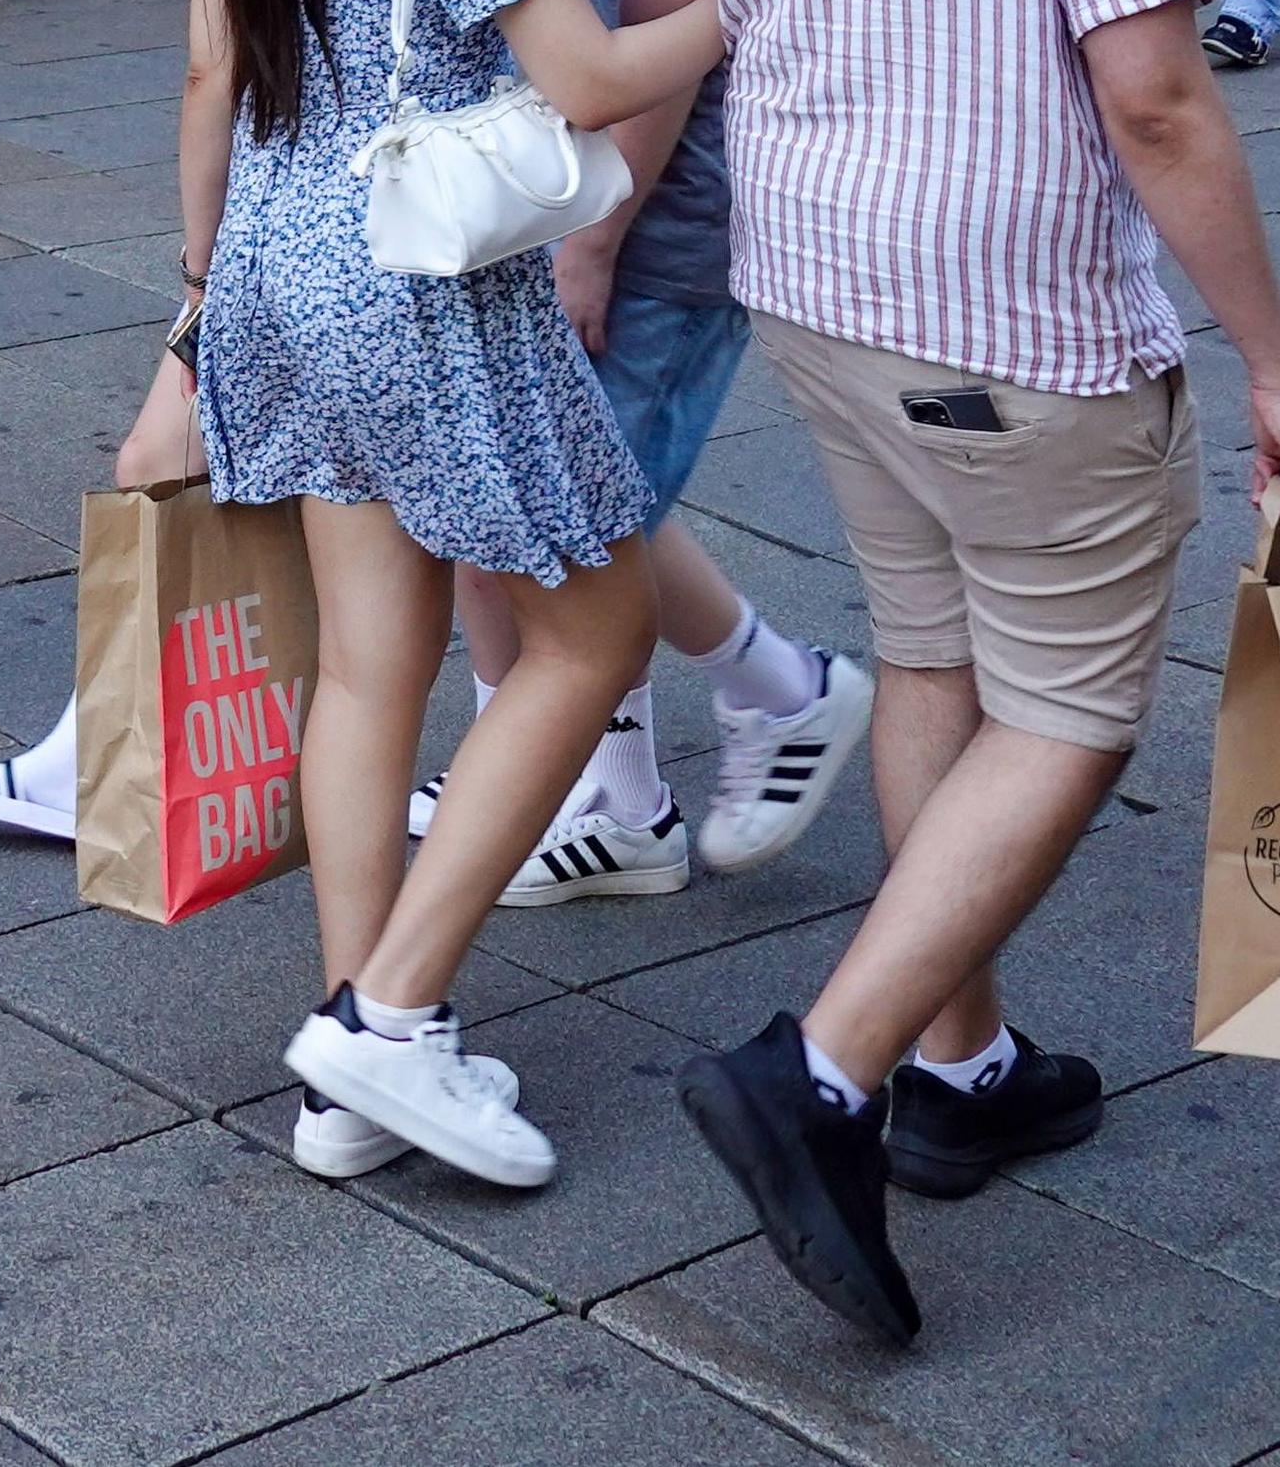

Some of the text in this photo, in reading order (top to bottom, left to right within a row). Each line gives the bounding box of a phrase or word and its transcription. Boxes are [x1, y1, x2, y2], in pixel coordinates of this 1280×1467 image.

[174, 593, 271, 686] THE
[183, 677, 305, 779] ONLY
[197, 777, 292, 872] BAG
